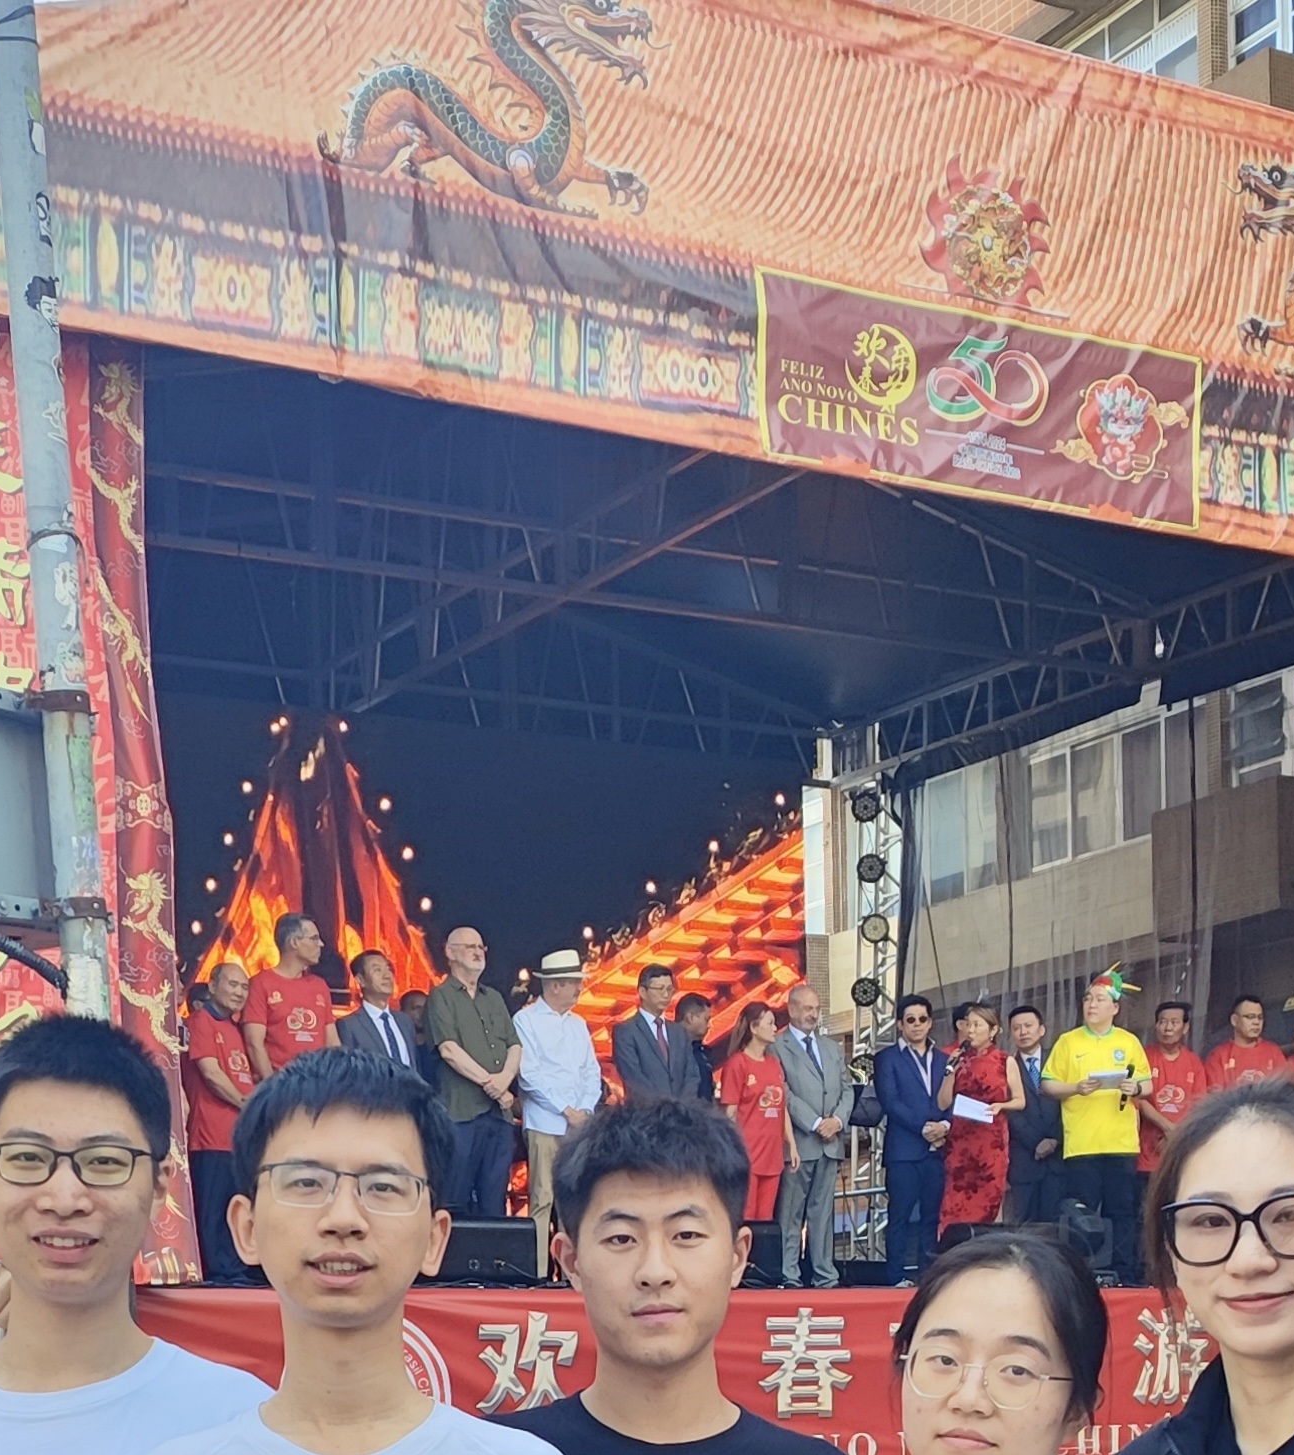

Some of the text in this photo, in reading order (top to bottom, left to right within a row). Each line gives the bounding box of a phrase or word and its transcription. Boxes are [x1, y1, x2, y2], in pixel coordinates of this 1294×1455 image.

[780, 357, 825, 381] FELIZ
[779, 376, 858, 404] ANO NOVO
